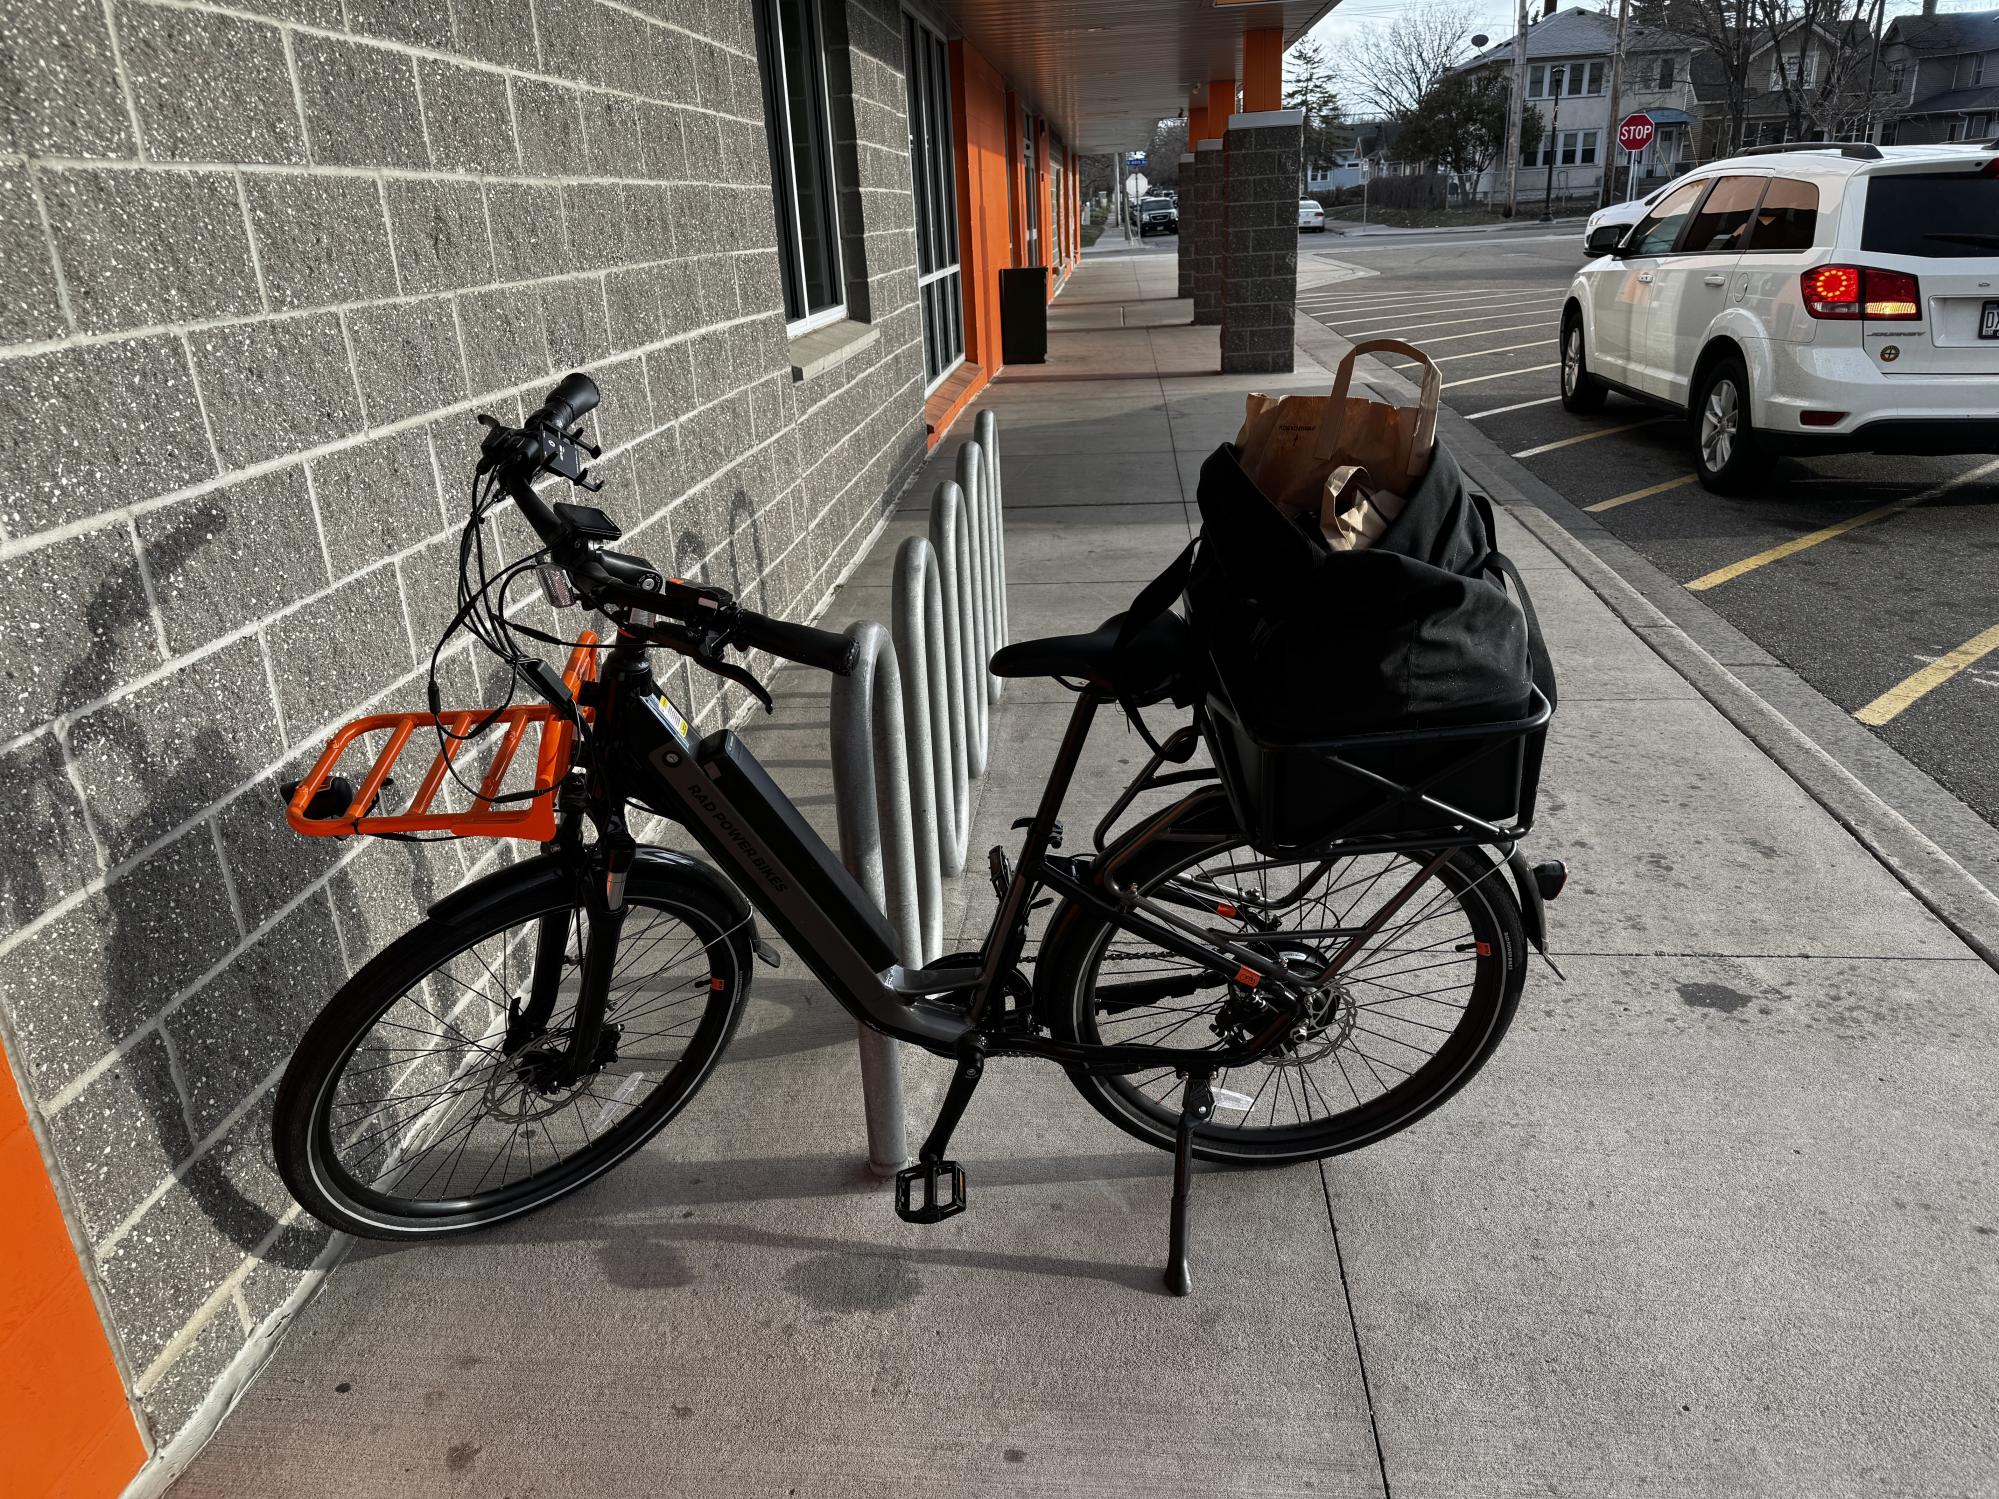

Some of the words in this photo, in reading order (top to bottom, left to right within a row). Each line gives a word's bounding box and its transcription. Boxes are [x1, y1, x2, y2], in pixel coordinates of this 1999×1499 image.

[1620, 125, 1652, 140] STOP
[687, 784, 717, 811] RAD
[712, 812, 757, 857] POWER
[751, 857, 788, 892] BIKES
